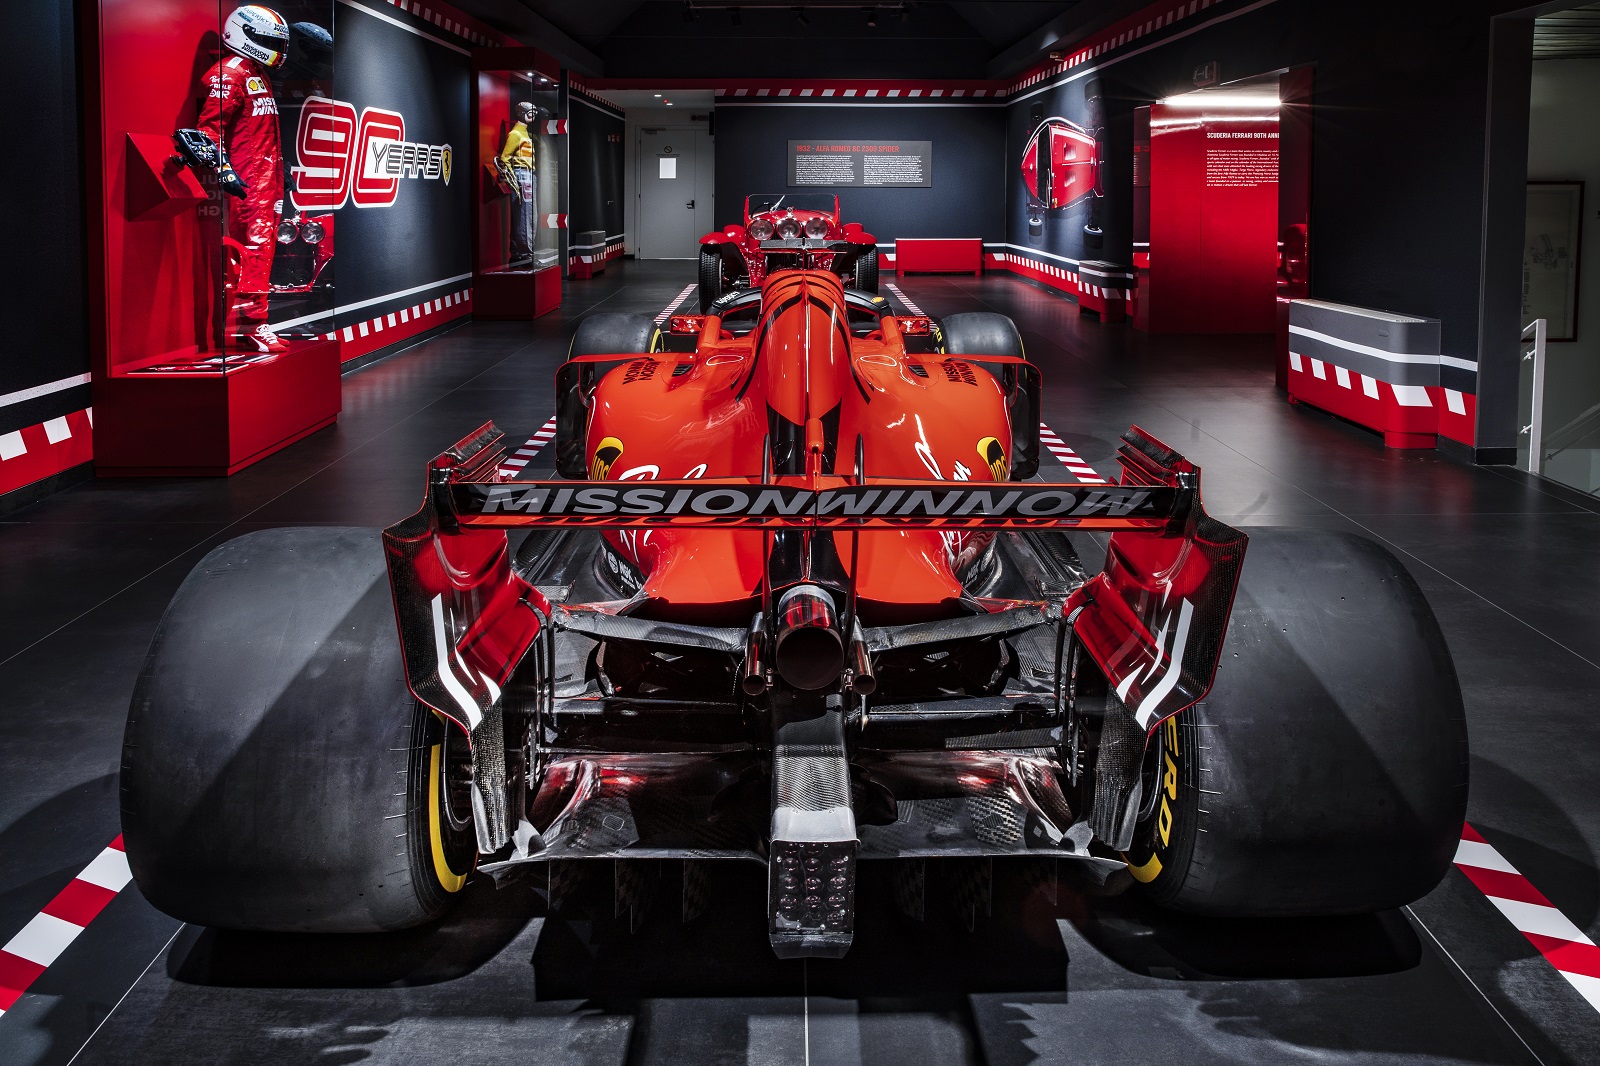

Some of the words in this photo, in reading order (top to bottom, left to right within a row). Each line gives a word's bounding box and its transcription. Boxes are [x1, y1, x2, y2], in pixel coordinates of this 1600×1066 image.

[290, 96, 405, 210] 90
[371, 141, 442, 176] YEARS
[830, 145, 851, 153] ROMEO
[861, 145, 877, 153] 2300
[481, 488, 815, 515] MISSION
[804, 489, 1151, 515] WINNOW
[1158, 715, 1180, 848] ERO
